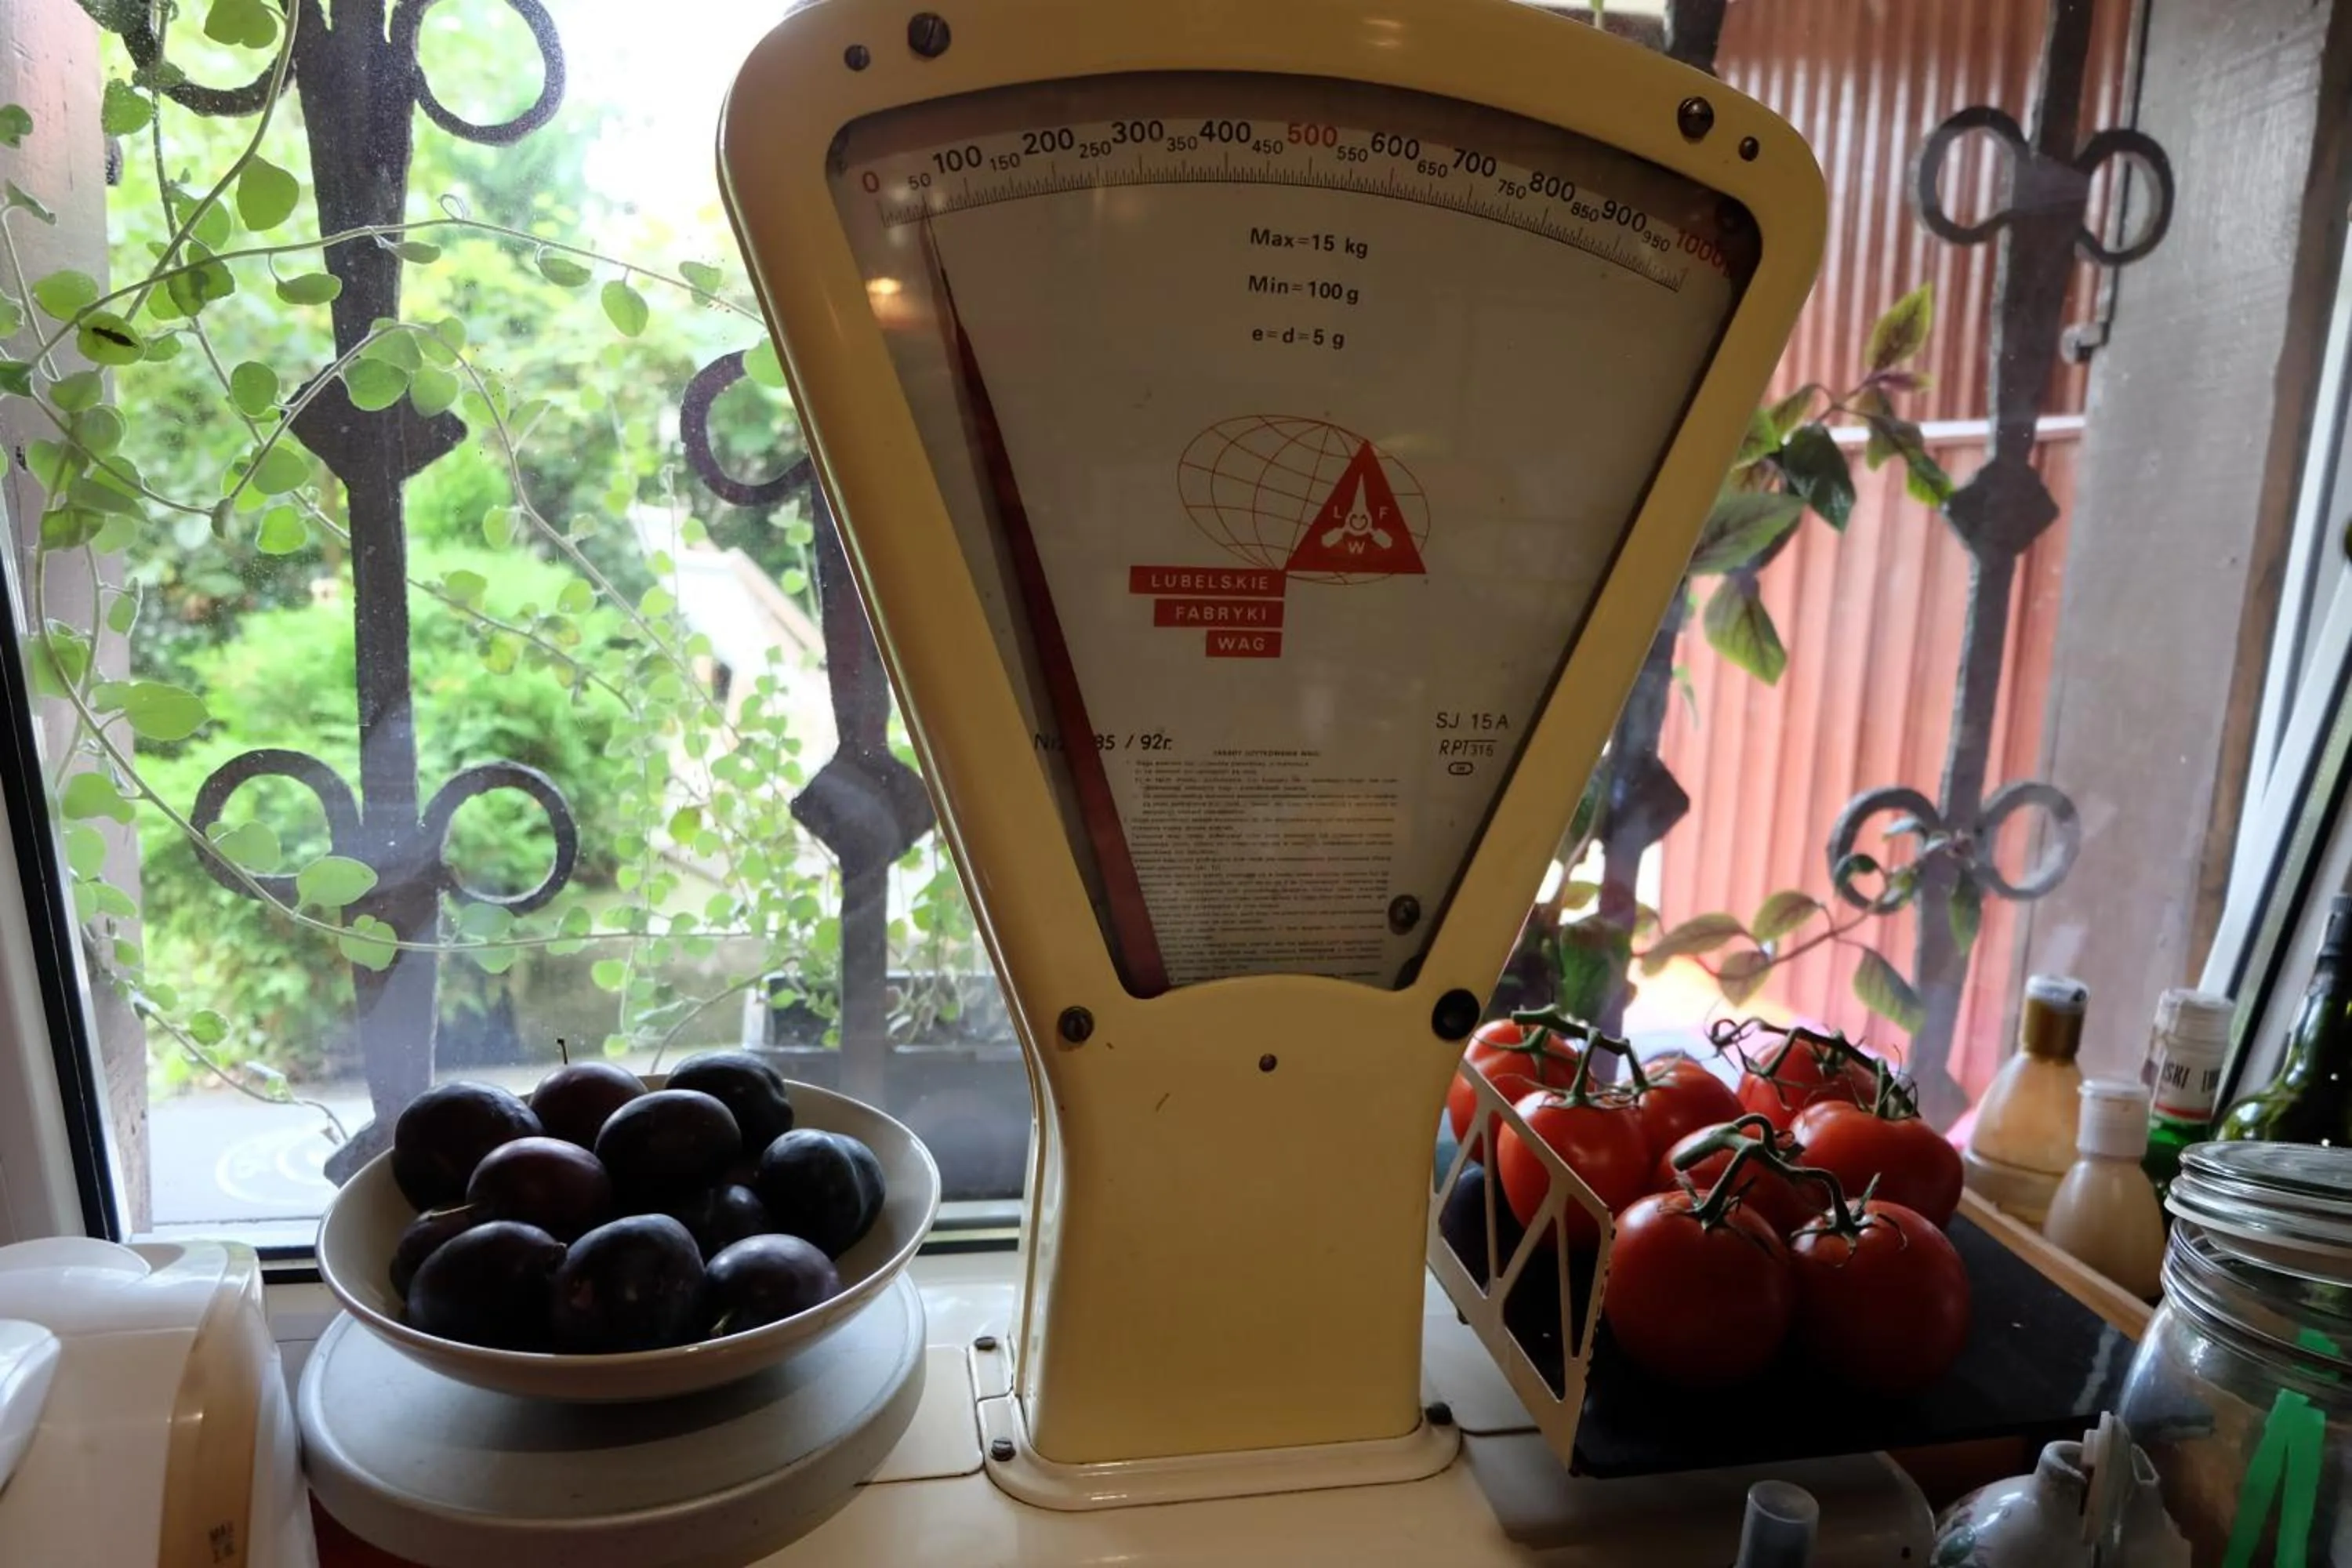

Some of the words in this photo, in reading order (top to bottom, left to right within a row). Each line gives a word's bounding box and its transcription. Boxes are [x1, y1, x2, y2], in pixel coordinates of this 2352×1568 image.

[862, 171, 880, 193] 0
[908, 172, 931, 190] 50
[933, 145, 982, 174] 100
[989, 152, 1021, 172] 150
[1022, 128, 1074, 155] 200
[1079, 140, 1112, 158] 250
[1111, 120, 1164, 143] 300
[1166, 136, 1198, 152] 350
[1200, 120, 1251, 143] 400
[1252, 139, 1284, 154] 450
[1287, 122, 1338, 147] 500
[1337, 145, 1368, 162] 550
[1370, 131, 1420, 161] 600
[1417, 159, 1448, 178] 650
[1453, 147, 1497, 177] 700
[1497, 179, 1526, 199] 750
[1529, 170, 1576, 202] 800
[1570, 201, 1599, 223] 850
[1601, 200, 1647, 233] 900
[1642, 230, 1671, 252] 950
[1345, 238, 1368, 260] kg
[1333, 504, 1343, 518] L
[1378, 506, 1389, 521] F
[1348, 540, 1366, 554] W
[1150, 573, 1269, 590] LUBELSKIE
[1175, 605, 1266, 621] FABRYKI
[1217, 636, 1265, 652] WAG
[1436, 712, 1460, 729] SJ
